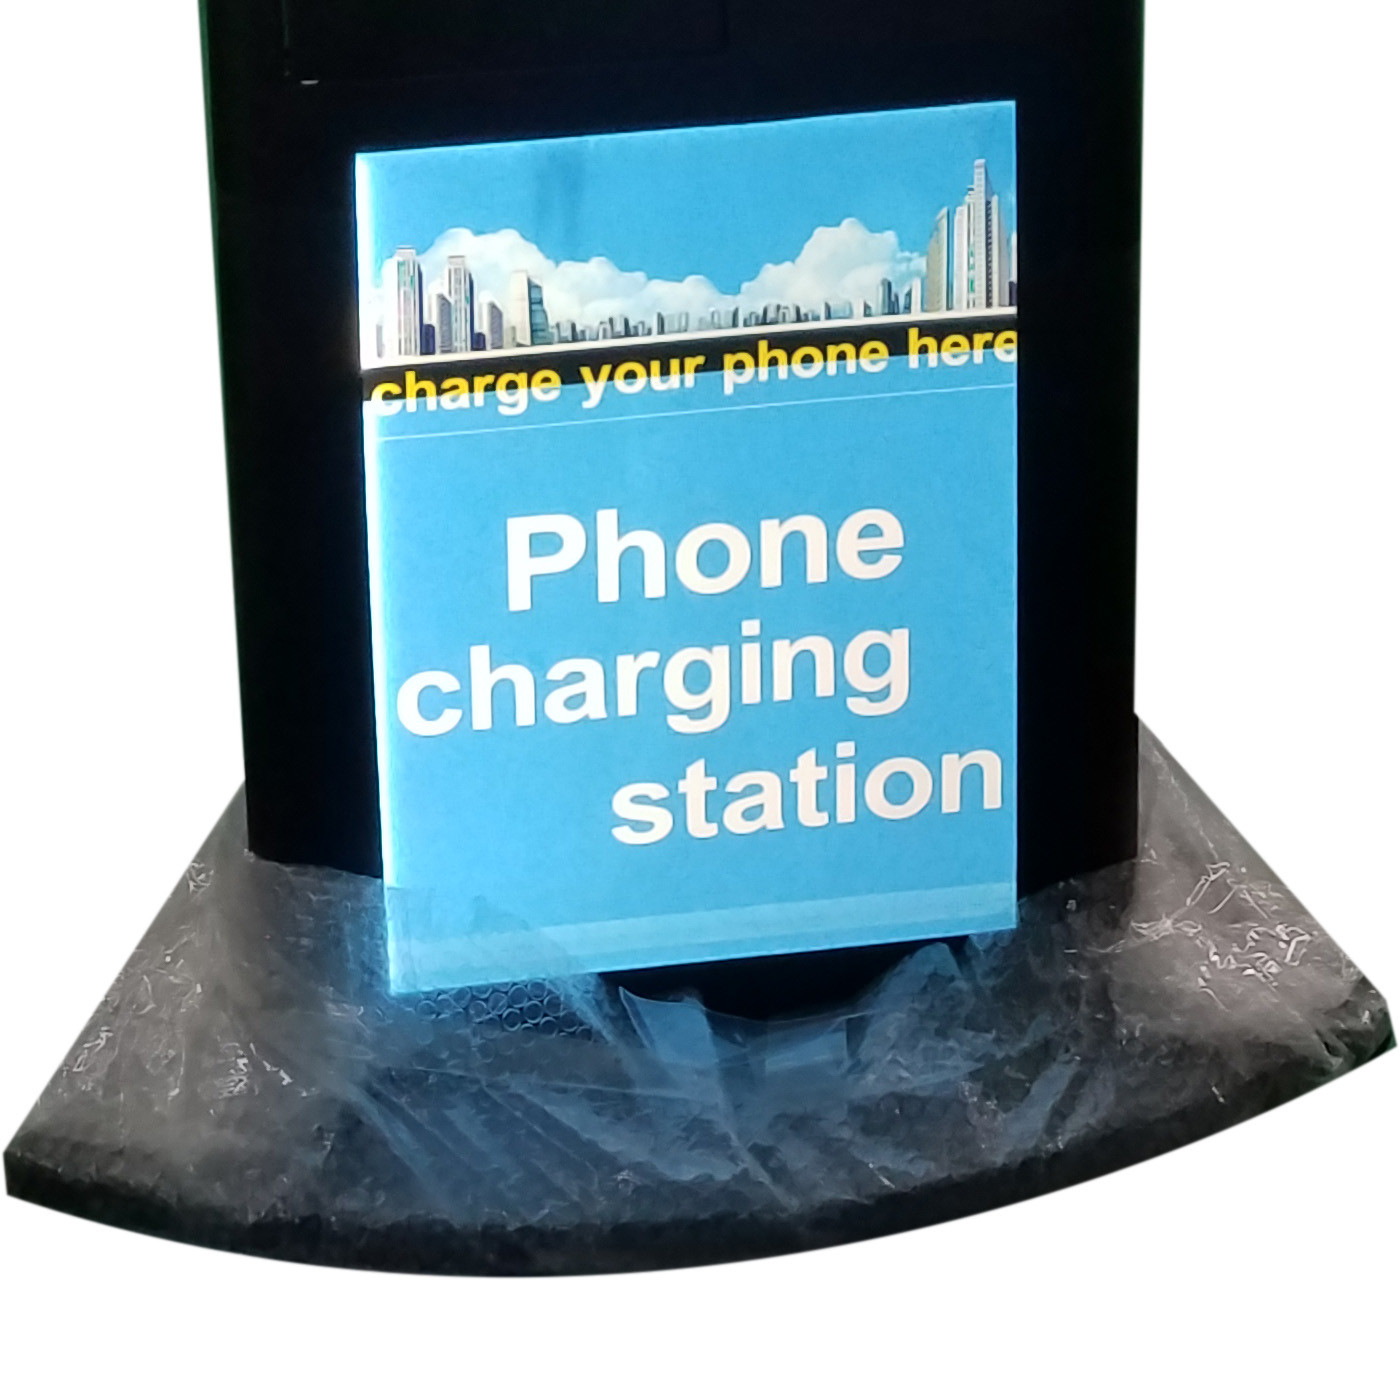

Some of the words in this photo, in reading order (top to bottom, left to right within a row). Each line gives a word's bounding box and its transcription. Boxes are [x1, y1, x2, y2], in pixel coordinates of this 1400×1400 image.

[370, 370, 562, 416] charge
[579, 355, 706, 408] your
[723, 339, 890, 395] phone
[908, 327, 1017, 369] here
[506, 507, 905, 612] Phone
[396, 619, 910, 737] charging
[611, 741, 1002, 845] station
